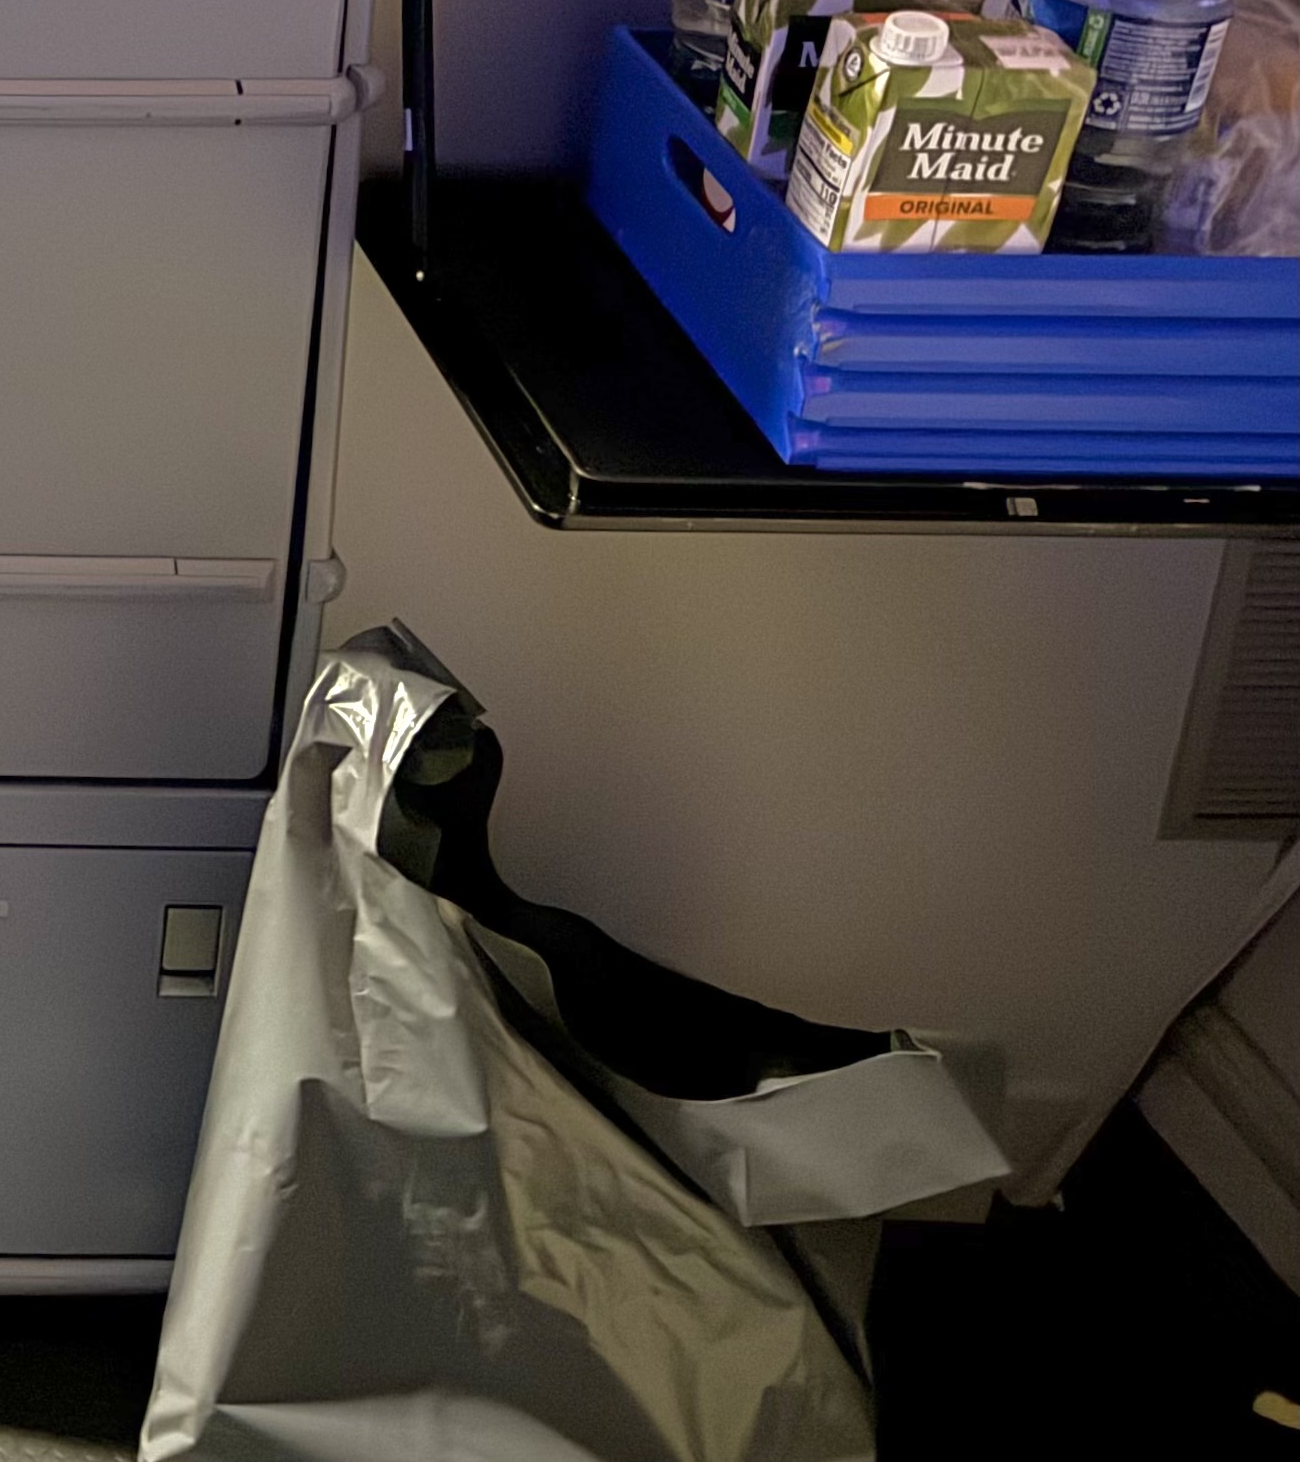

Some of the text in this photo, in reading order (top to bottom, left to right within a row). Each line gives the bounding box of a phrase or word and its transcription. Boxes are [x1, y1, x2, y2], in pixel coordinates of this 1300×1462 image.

[898, 121, 1044, 154] Minute
[906, 152, 1017, 182] Maid
[899, 199, 995, 216] ORIGINAL
